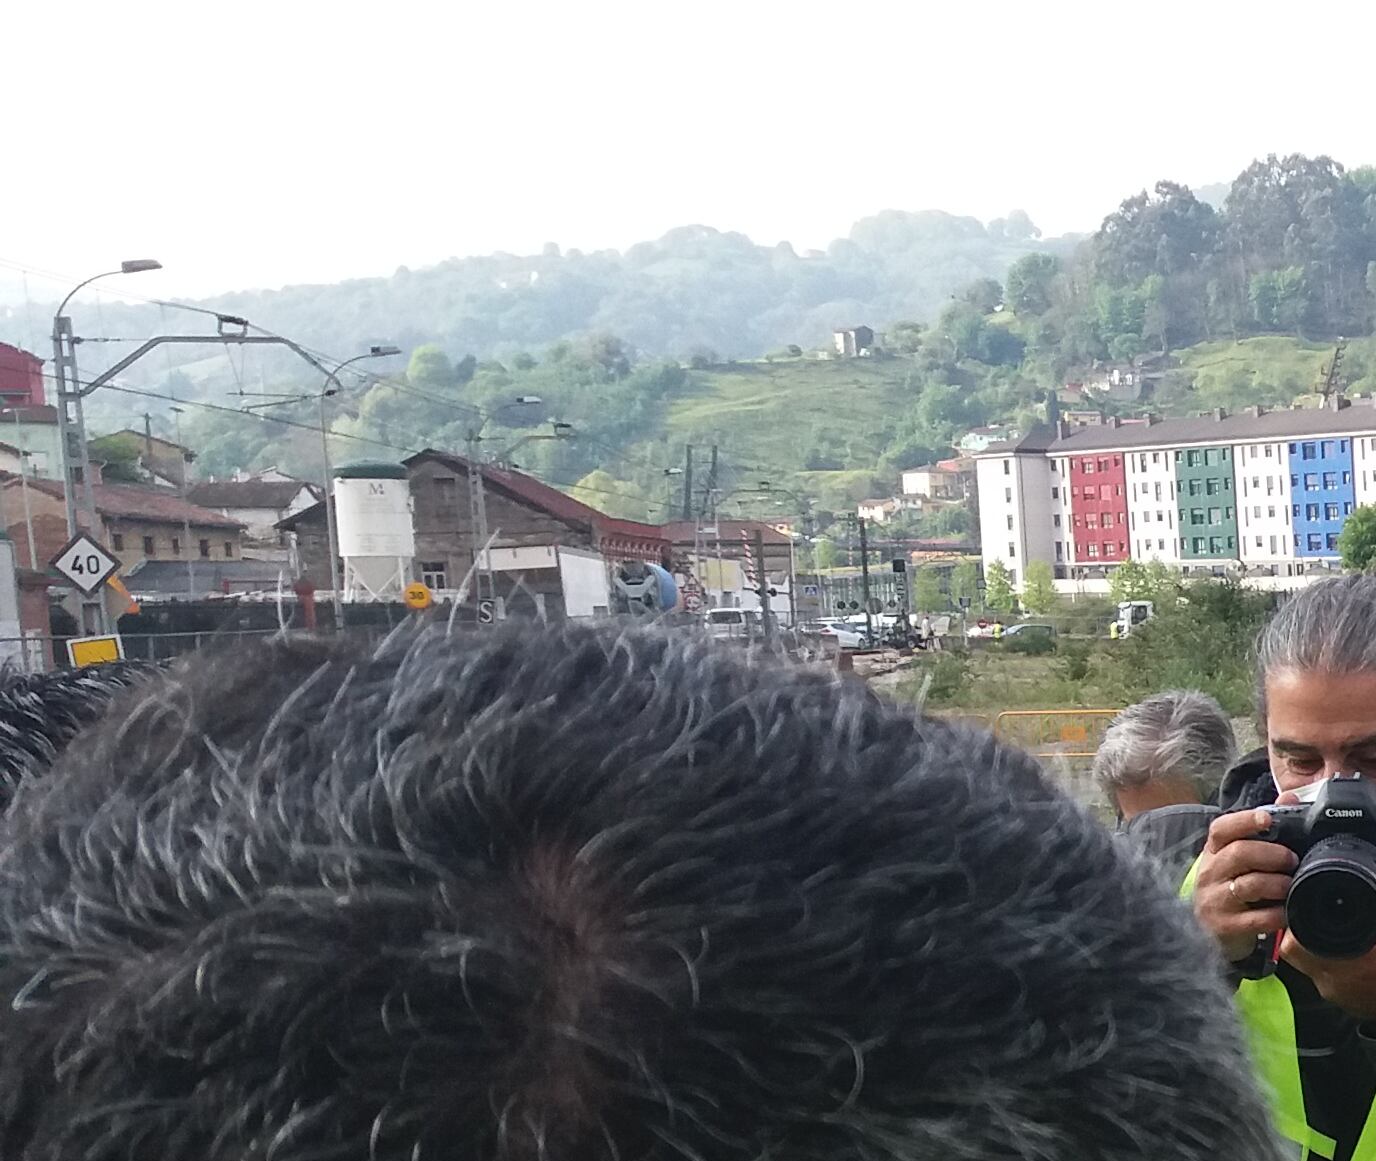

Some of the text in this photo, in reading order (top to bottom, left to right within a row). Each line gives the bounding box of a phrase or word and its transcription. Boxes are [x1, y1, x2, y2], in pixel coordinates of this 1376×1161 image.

[72, 555, 100, 575] 40
[480, 602, 493, 623] S
[1325, 808, 1363, 817] Canon
